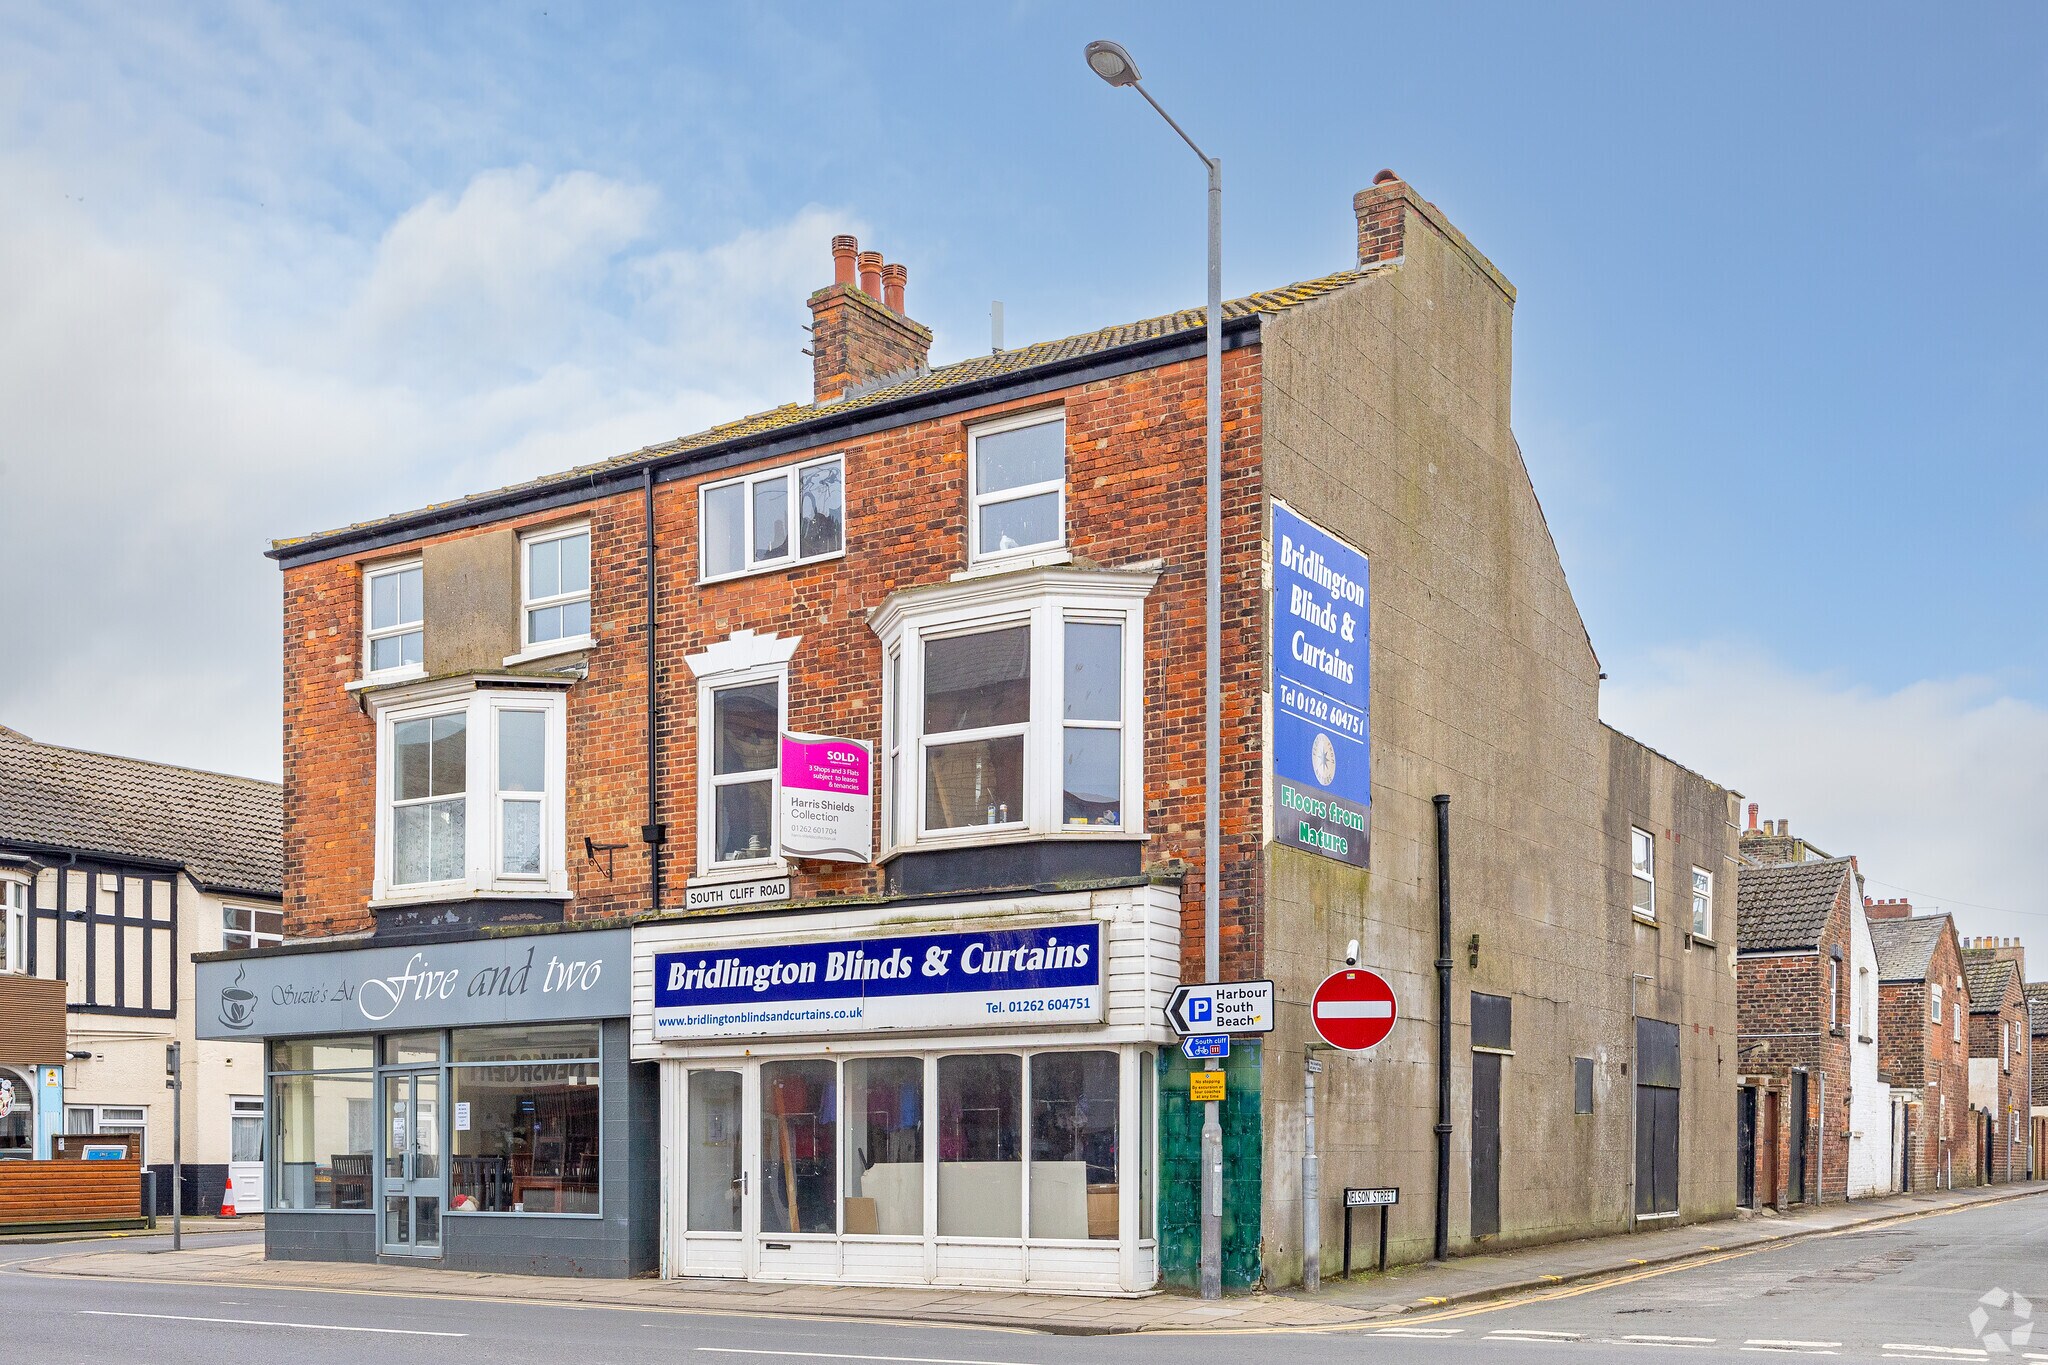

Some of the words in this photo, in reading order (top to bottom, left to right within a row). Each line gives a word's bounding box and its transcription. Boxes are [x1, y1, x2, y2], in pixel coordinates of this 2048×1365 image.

[1280, 534, 1365, 608] Bridlington
[1290, 583, 1337, 634] Blinds
[1340, 611, 1356, 643] &
[1291, 630, 1354, 684] Curtains
[1280, 685, 1295, 703] Tel
[1297, 694, 1327, 720] 01262
[1330, 706, 1364, 735] 604751
[827, 751, 855, 762] SOLD
[813, 765, 830, 774] Shops
[847, 769, 859, 777] Flats
[813, 773, 833, 781] subject
[842, 775, 858, 783] leases
[834, 782, 859, 790] tenancies
[791, 797, 820, 809] Harris
[821, 800, 855, 812] Shields
[1281, 785, 1326, 819] Floors
[1329, 802, 1364, 831] from
[791, 808, 839, 822] Collection
[791, 824, 812, 833] 01262
[813, 826, 837, 835] 601704
[1299, 821, 1348, 855] Nature
[690, 890, 723, 904] SOUTH
[729, 886, 755, 900] CLIFF
[760, 883, 785, 897] ROAD
[666, 957, 817, 992] Bridlington
[824, 948, 913, 982] Blinds
[921, 945, 952, 977] &
[960, 937, 1090, 974] Curtains
[271, 982, 328, 1006] Suzie's
[330, 978, 355, 1002] At
[466, 945, 535, 998] and
[543, 955, 603, 993] two
[1216, 988, 1267, 1000] Harbour
[658, 1007, 863, 1026] www.bridlingtonblindsandcurtains.co.uk
[986, 1002, 1005, 1013] Tel.
[1008, 1000, 1044, 1013] 01262
[1047, 997, 1090, 1011] 604751
[1194, 1000, 1209, 1020] P
[1216, 1002, 1253, 1013] South
[1216, 1015, 1254, 1026] Beach
[1373, 1190, 1394, 1202] STREET
